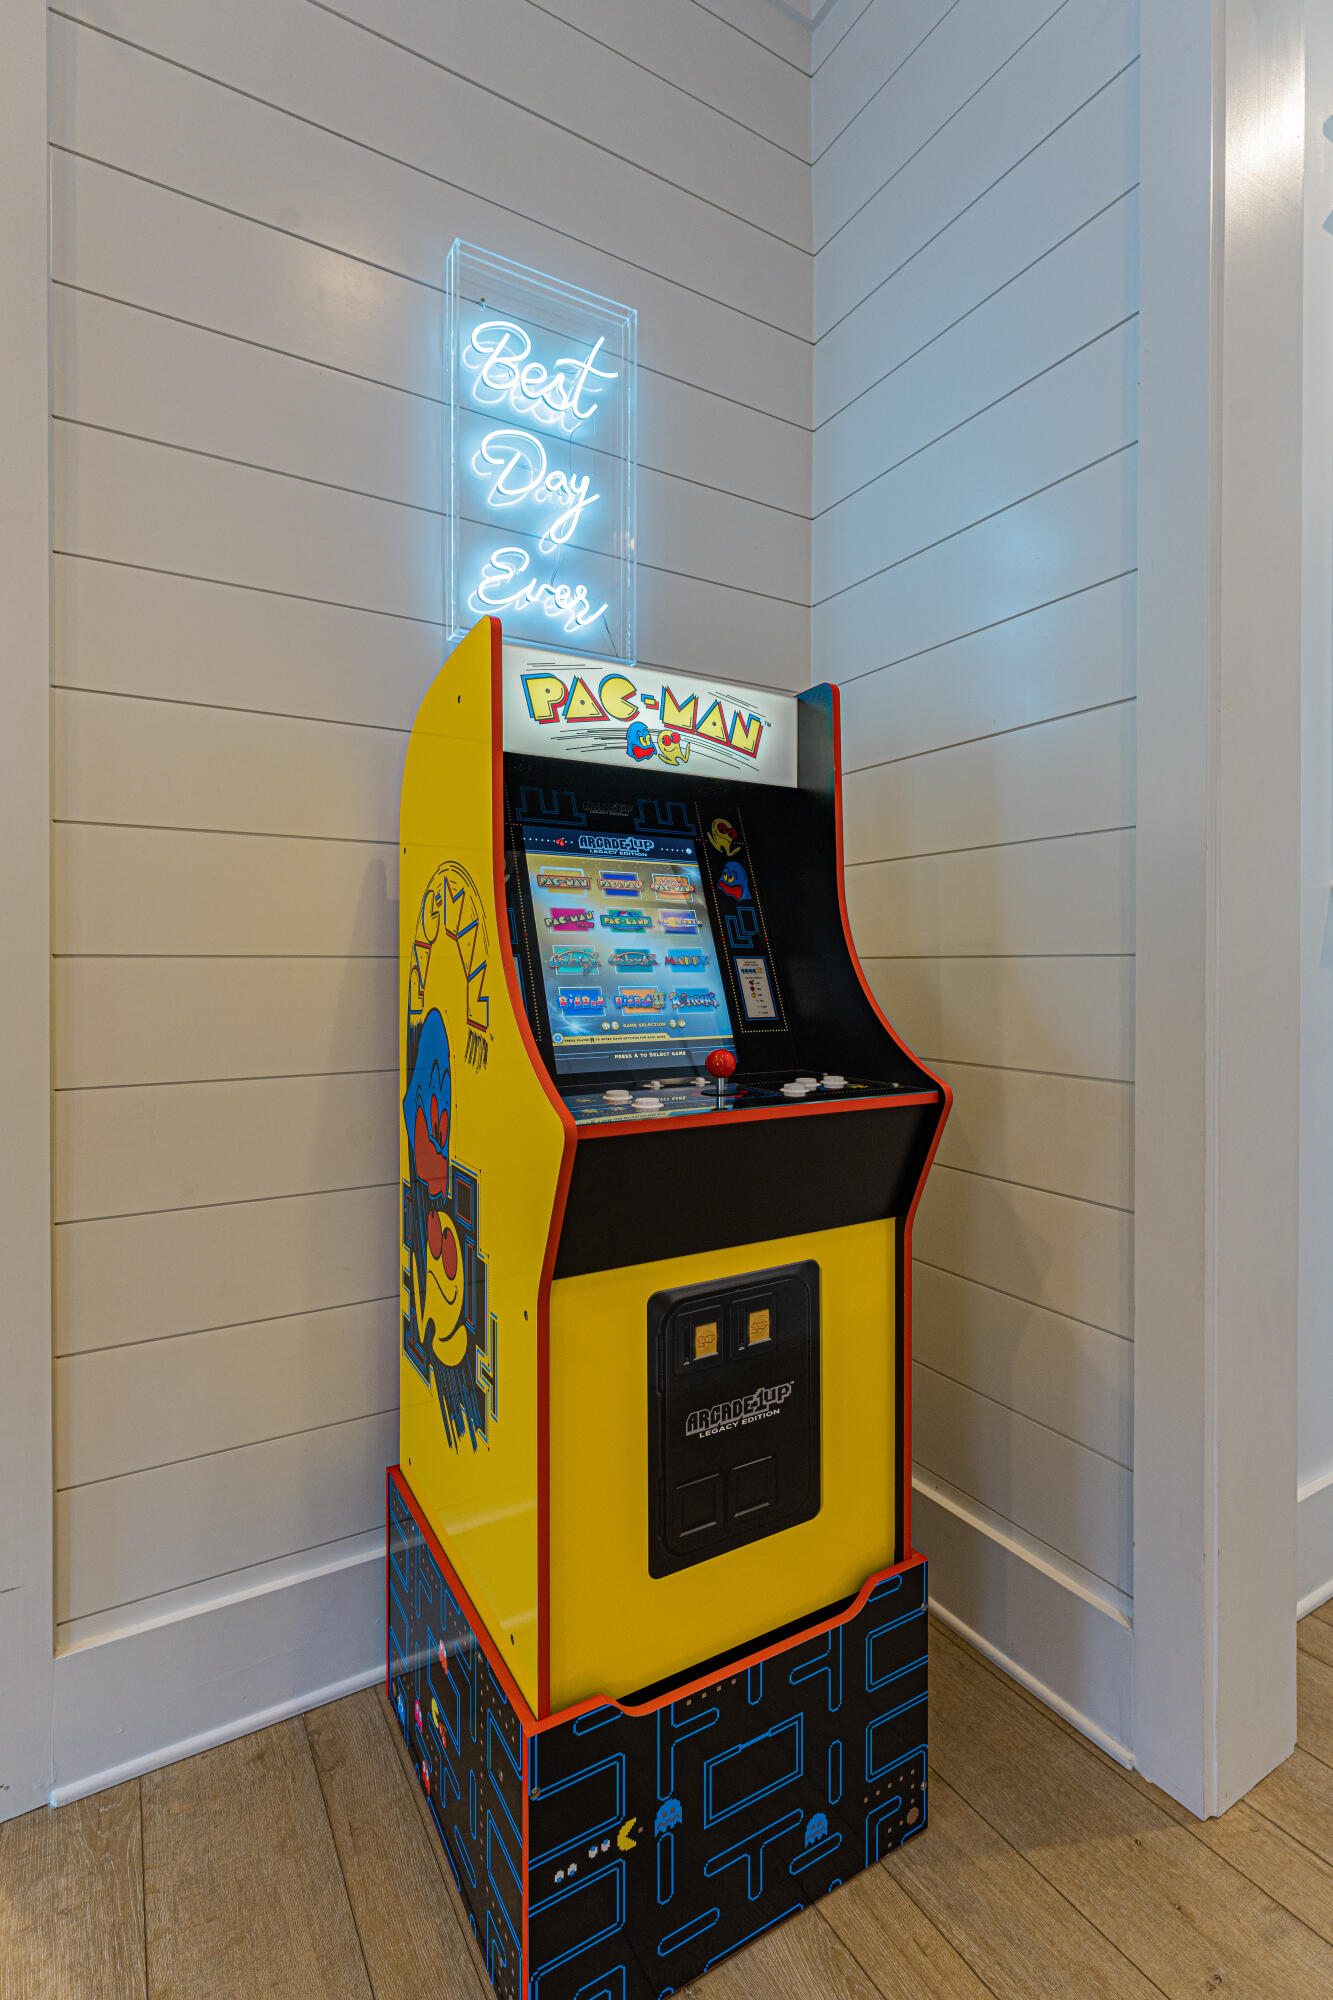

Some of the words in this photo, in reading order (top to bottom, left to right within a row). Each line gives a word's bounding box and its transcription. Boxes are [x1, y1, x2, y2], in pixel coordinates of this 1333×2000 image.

[471, 320, 619, 420] Best
[480, 429, 601, 544] Day
[477, 546, 609, 626] Ever
[520, 672, 764, 759] PAC-MAN
[539, 876, 589, 888] PAC-MAN
[699, 1421, 739, 1438] LEGACY
[741, 1408, 780, 1425] EDITION
